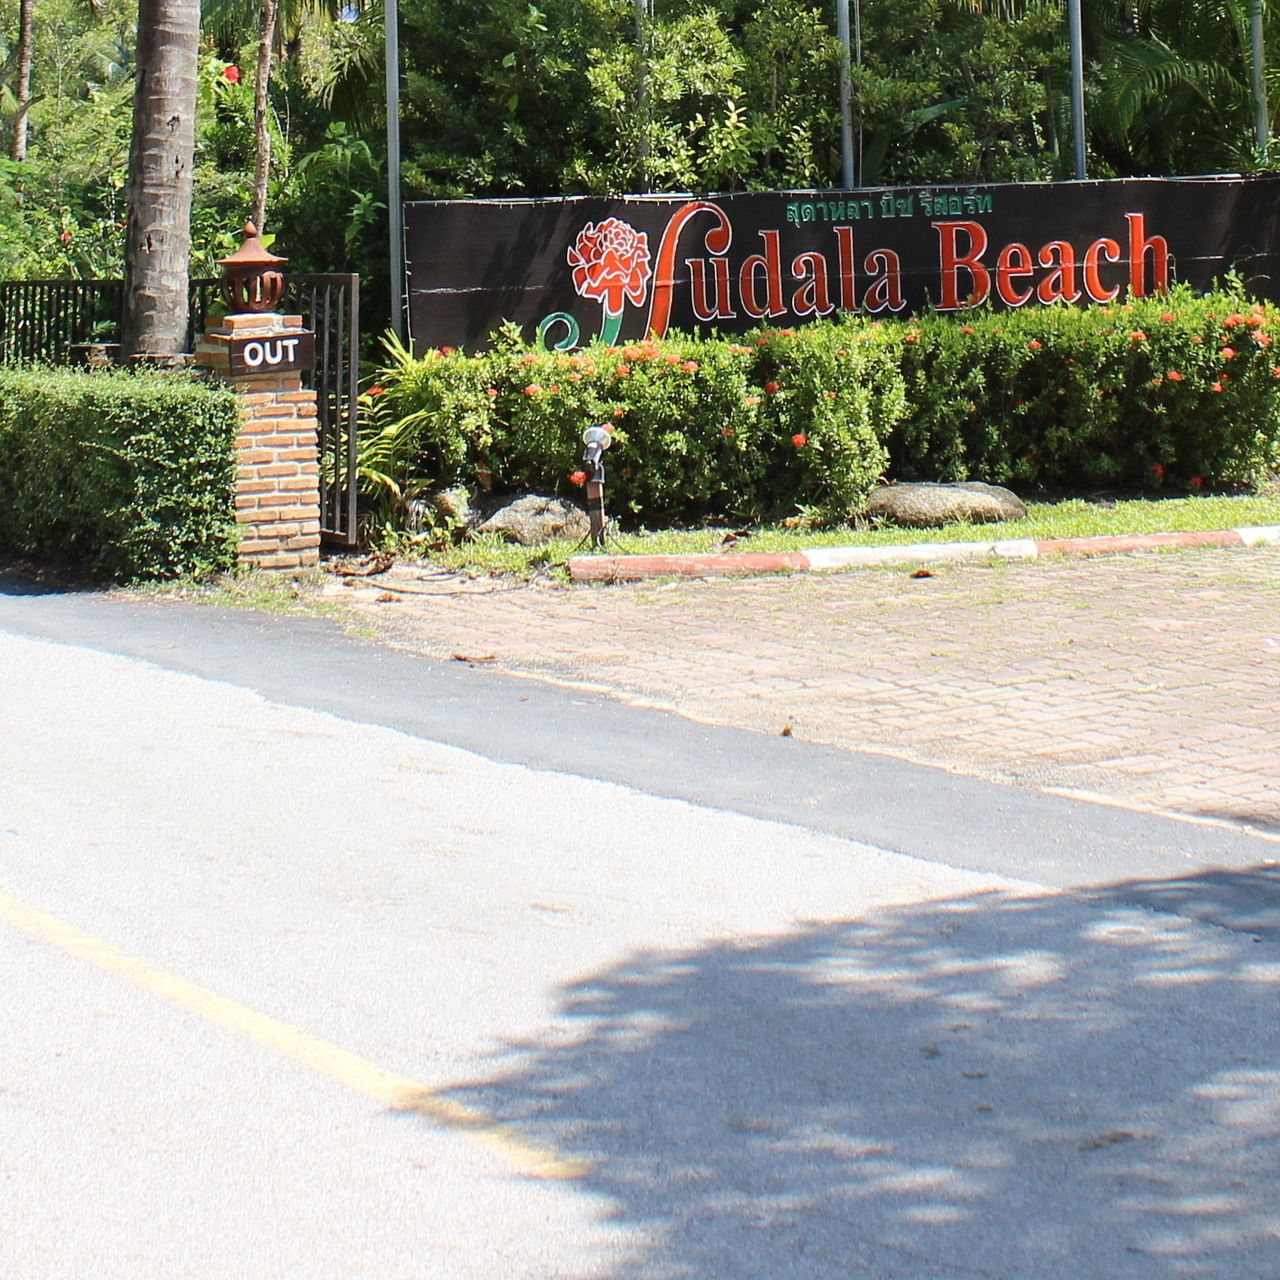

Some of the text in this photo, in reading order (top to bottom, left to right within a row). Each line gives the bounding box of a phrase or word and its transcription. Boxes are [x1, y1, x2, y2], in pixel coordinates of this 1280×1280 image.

[786, 200, 874, 229] สุดาหลา
[930, 211, 1170, 312] Beach
[243, 338, 299, 367] OUT
